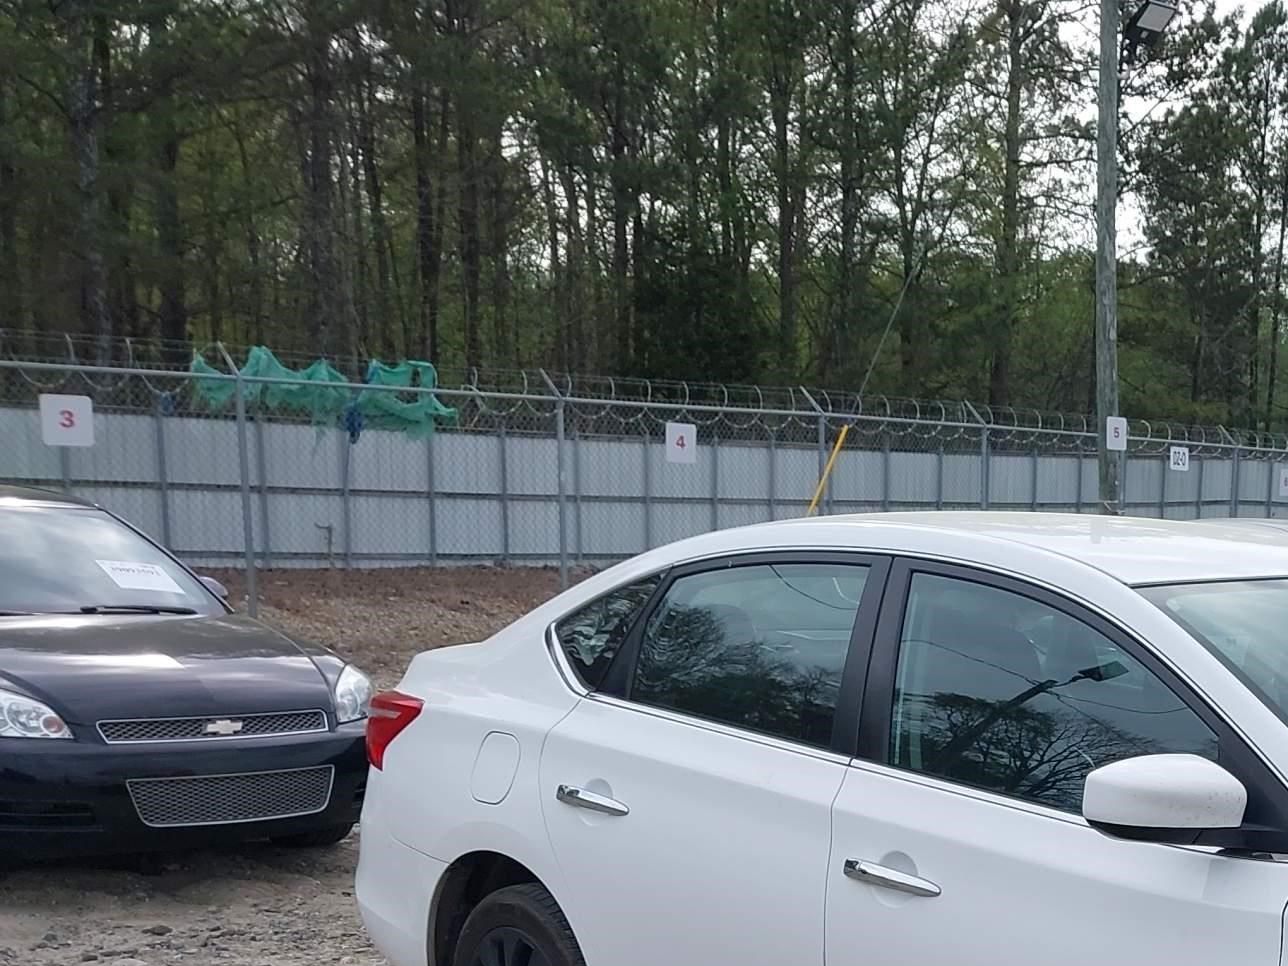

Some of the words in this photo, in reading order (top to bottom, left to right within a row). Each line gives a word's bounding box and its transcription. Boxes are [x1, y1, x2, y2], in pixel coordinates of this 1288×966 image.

[59, 410, 75, 428] 3
[1113, 427, 1120, 438] 5
[676, 435, 686, 448] 4
